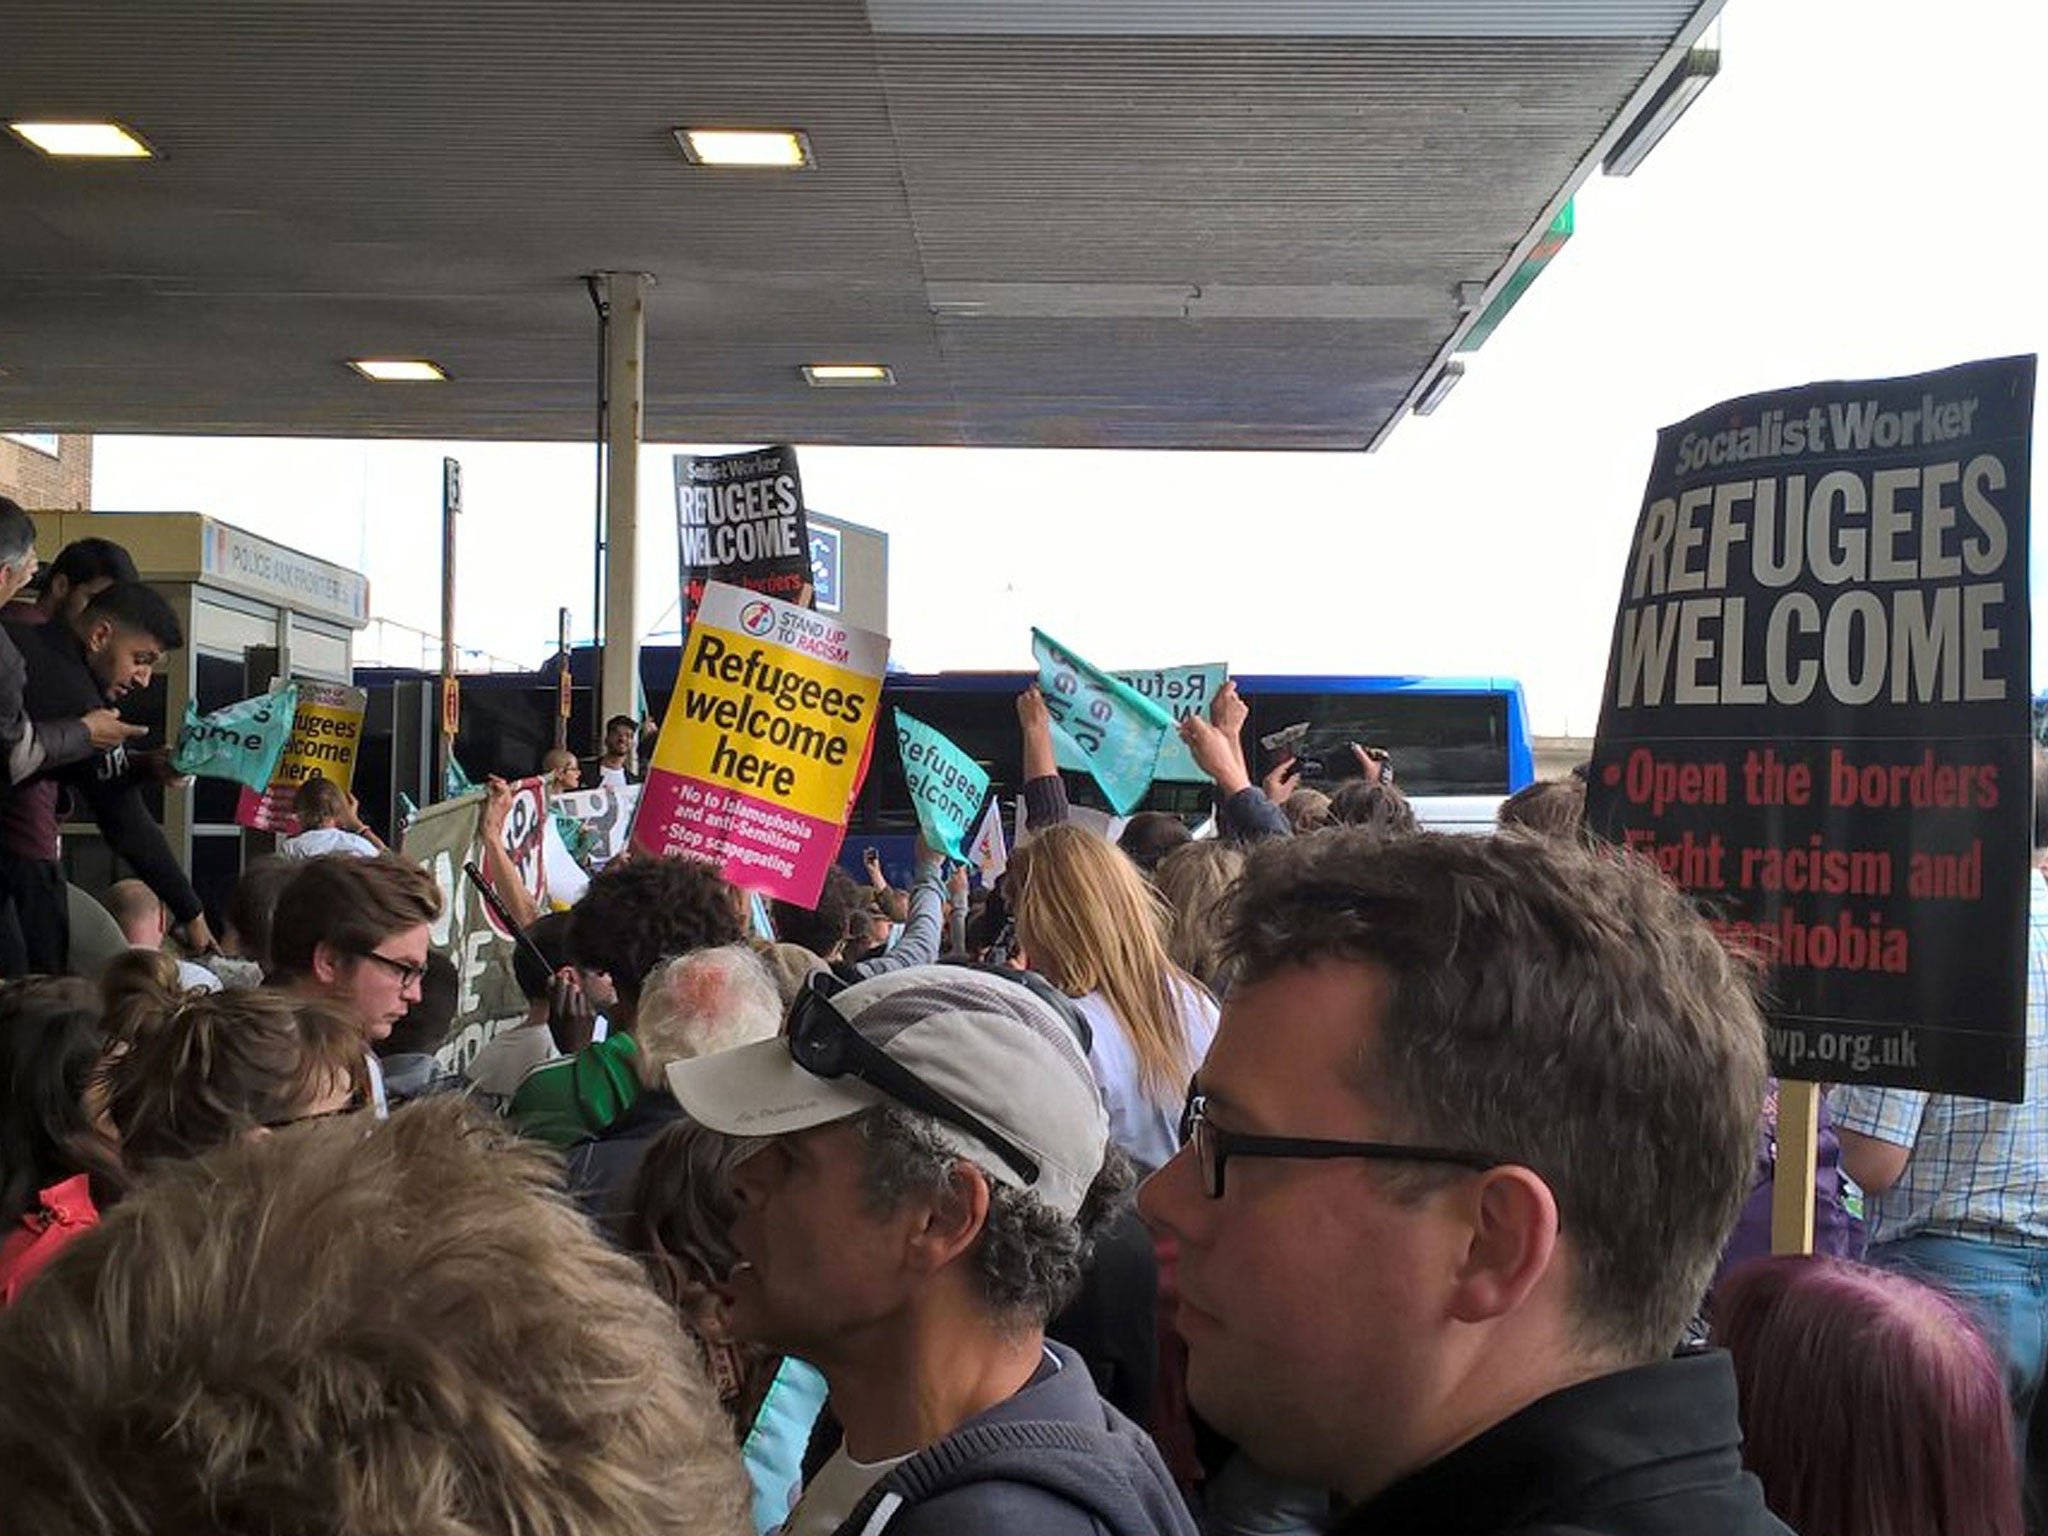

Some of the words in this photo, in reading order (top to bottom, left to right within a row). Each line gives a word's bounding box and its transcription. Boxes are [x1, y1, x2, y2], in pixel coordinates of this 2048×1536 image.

[681, 516, 800, 567] WELCOME
[1631, 454, 2008, 599] REFUGEES
[777, 626, 795, 644] TO
[796, 635, 850, 663] RACISM
[779, 611, 823, 637] STAND
[825, 626, 848, 645] UP
[1617, 583, 2006, 708] WELCOME
[692, 634, 865, 723] Refugees
[187, 723, 262, 750] ome
[686, 688, 848, 765] welcome
[710, 734, 795, 796] here
[898, 727, 982, 810] Refugees
[1625, 748, 1727, 817] Open
[1744, 748, 1810, 806] the
[1831, 748, 1999, 809] borders
[674, 804, 704, 822] and
[705, 811, 801, 854] anti-Semitism
[679, 784, 701, 803] No
[704, 791, 720, 809] to
[721, 798, 812, 839] Islamophobia
[668, 823, 702, 848] Stop
[705, 836, 796, 879] scapegoating
[1740, 834, 1891, 896] racism
[1908, 840, 1983, 899] and
[1768, 1028, 1917, 1071] wp.org.uk
